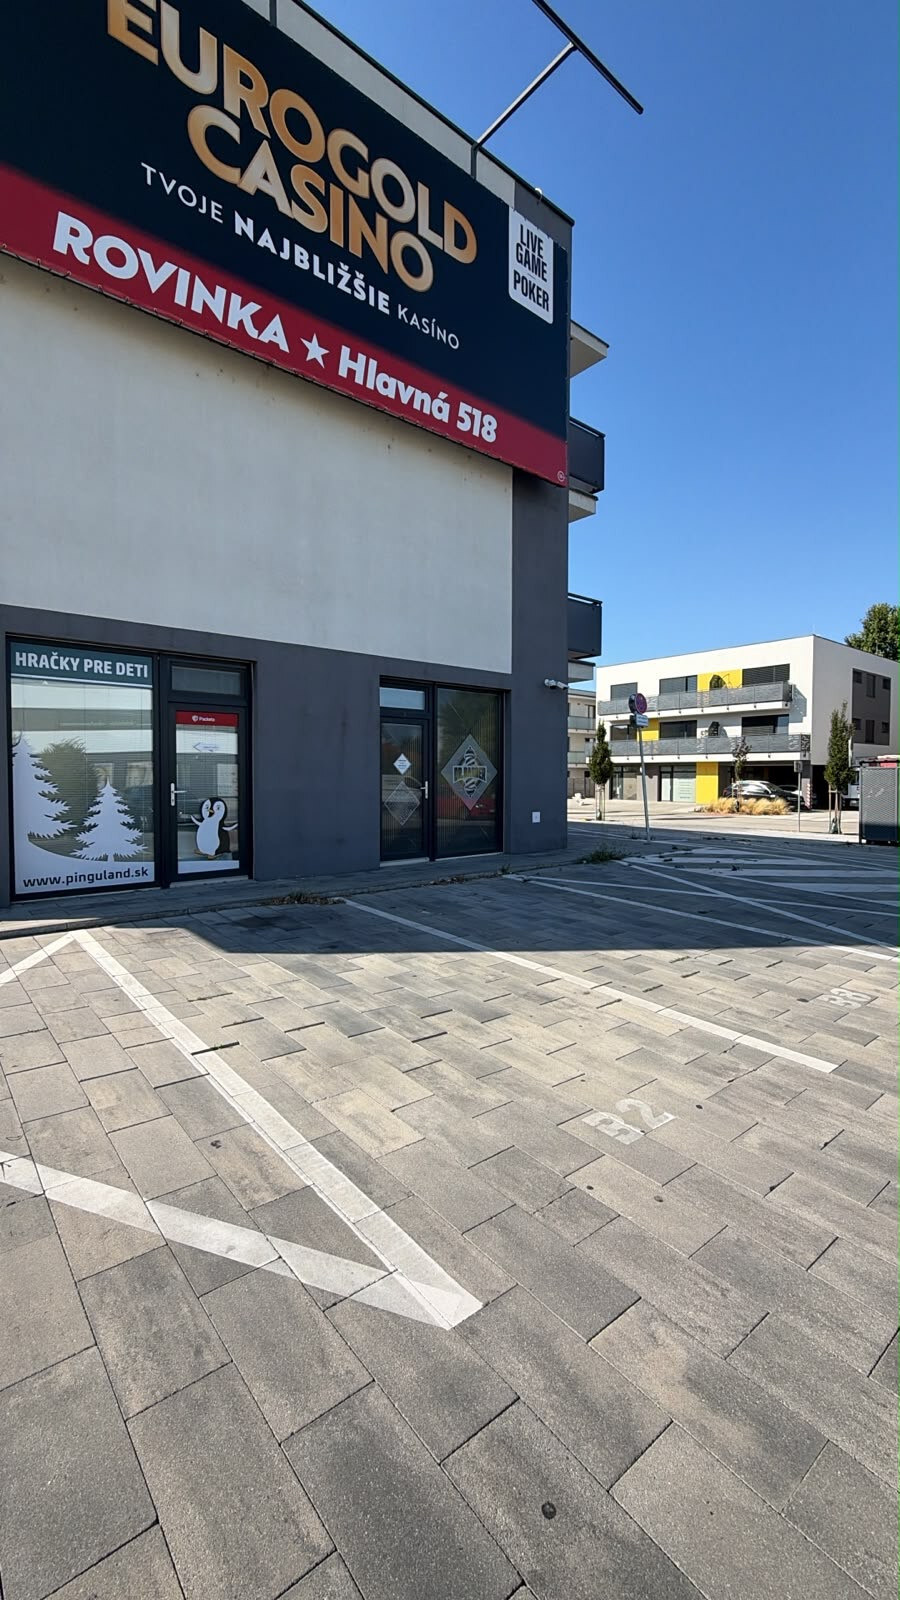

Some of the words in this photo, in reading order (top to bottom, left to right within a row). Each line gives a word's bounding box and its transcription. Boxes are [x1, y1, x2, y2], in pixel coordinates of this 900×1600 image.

[107, 0, 478, 265] EUROGOLD
[187, 104, 434, 293] CASINO
[141, 162, 224, 224] TVOJE
[234, 210, 390, 315] NAJBLIŽŠIE
[397, 303, 460, 350] KASÍNO
[515, 242, 548, 283] GAME
[520, 223, 544, 259] LIVE
[513, 269, 550, 313] POKER
[52, 211, 290, 353] ROVINKA
[338, 344, 451, 424] Hlavná
[456, 401, 498, 443] 518
[15, 651, 80, 672] HRAČKY
[83, 658, 113, 675] PRE
[115, 661, 148, 678] DETI
[22, 866, 149, 888] www.pinguland.sk
